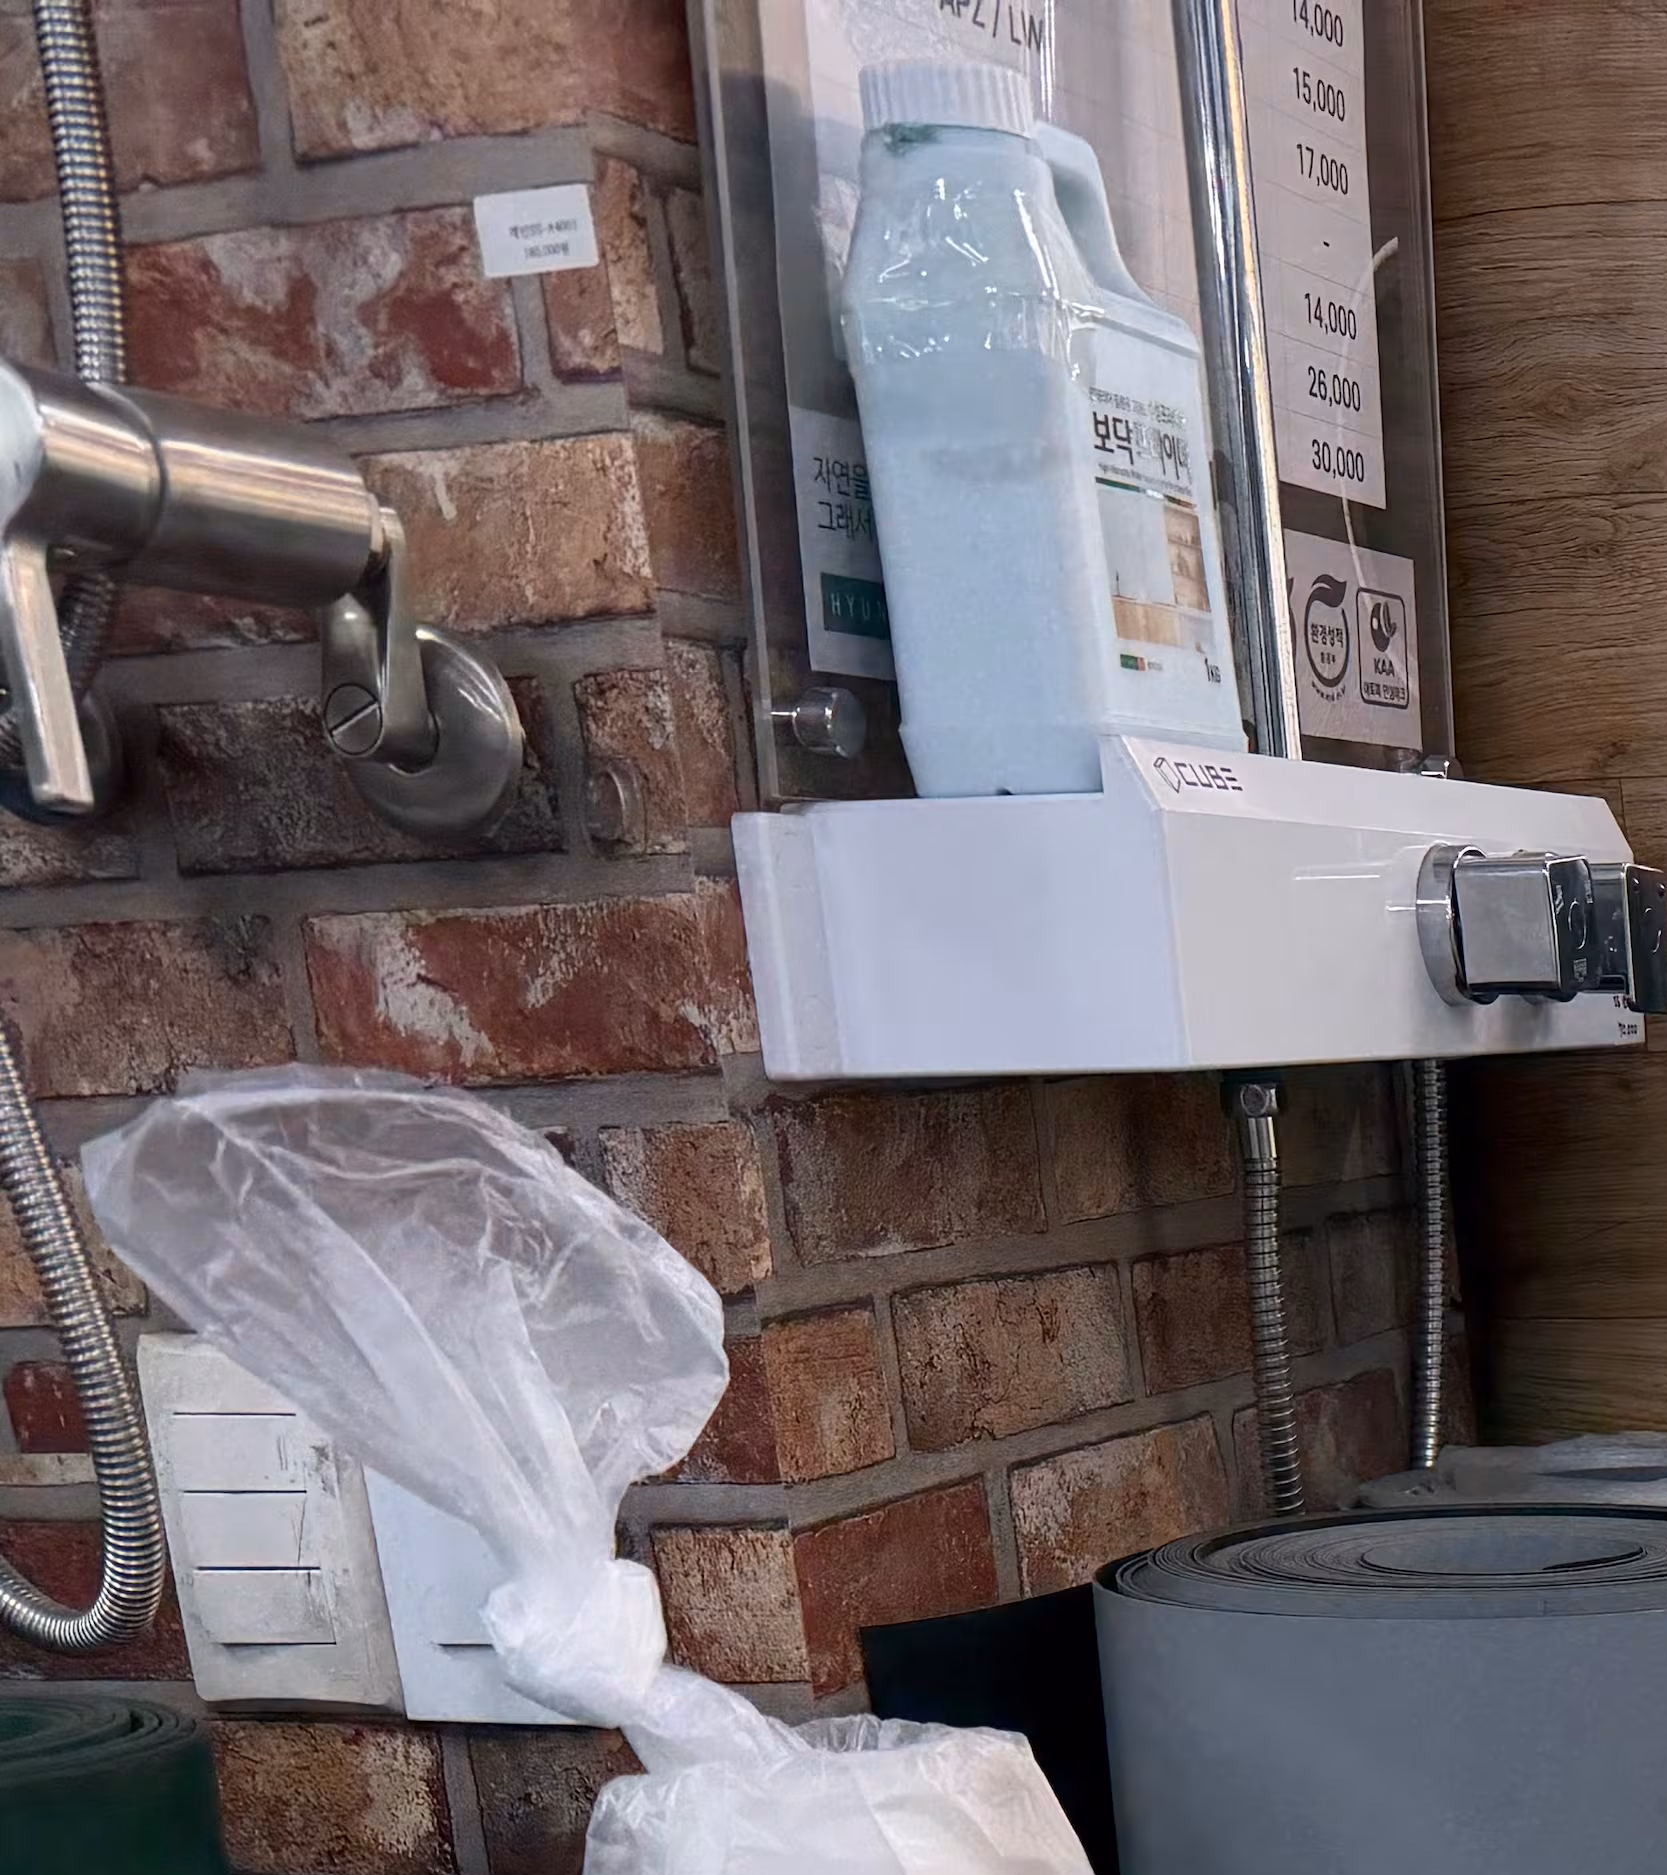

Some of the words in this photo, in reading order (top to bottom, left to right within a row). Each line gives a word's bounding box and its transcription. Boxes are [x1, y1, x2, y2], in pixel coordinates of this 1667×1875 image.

[1292, 0, 1344, 47] 14,000
[1293, 67, 1345, 122] 15,000
[1296, 144, 1348, 195] 17,000
[1304, 292, 1357, 340] 14,000
[1308, 365, 1361, 412] 26,000
[813, 457, 869, 500] 자연을
[1312, 438, 1364, 482] 30,000
[818, 501, 873, 542] 그래서
[1373, 658, 1395, 678] KAA
[1174, 761, 1244, 792] CUBE
